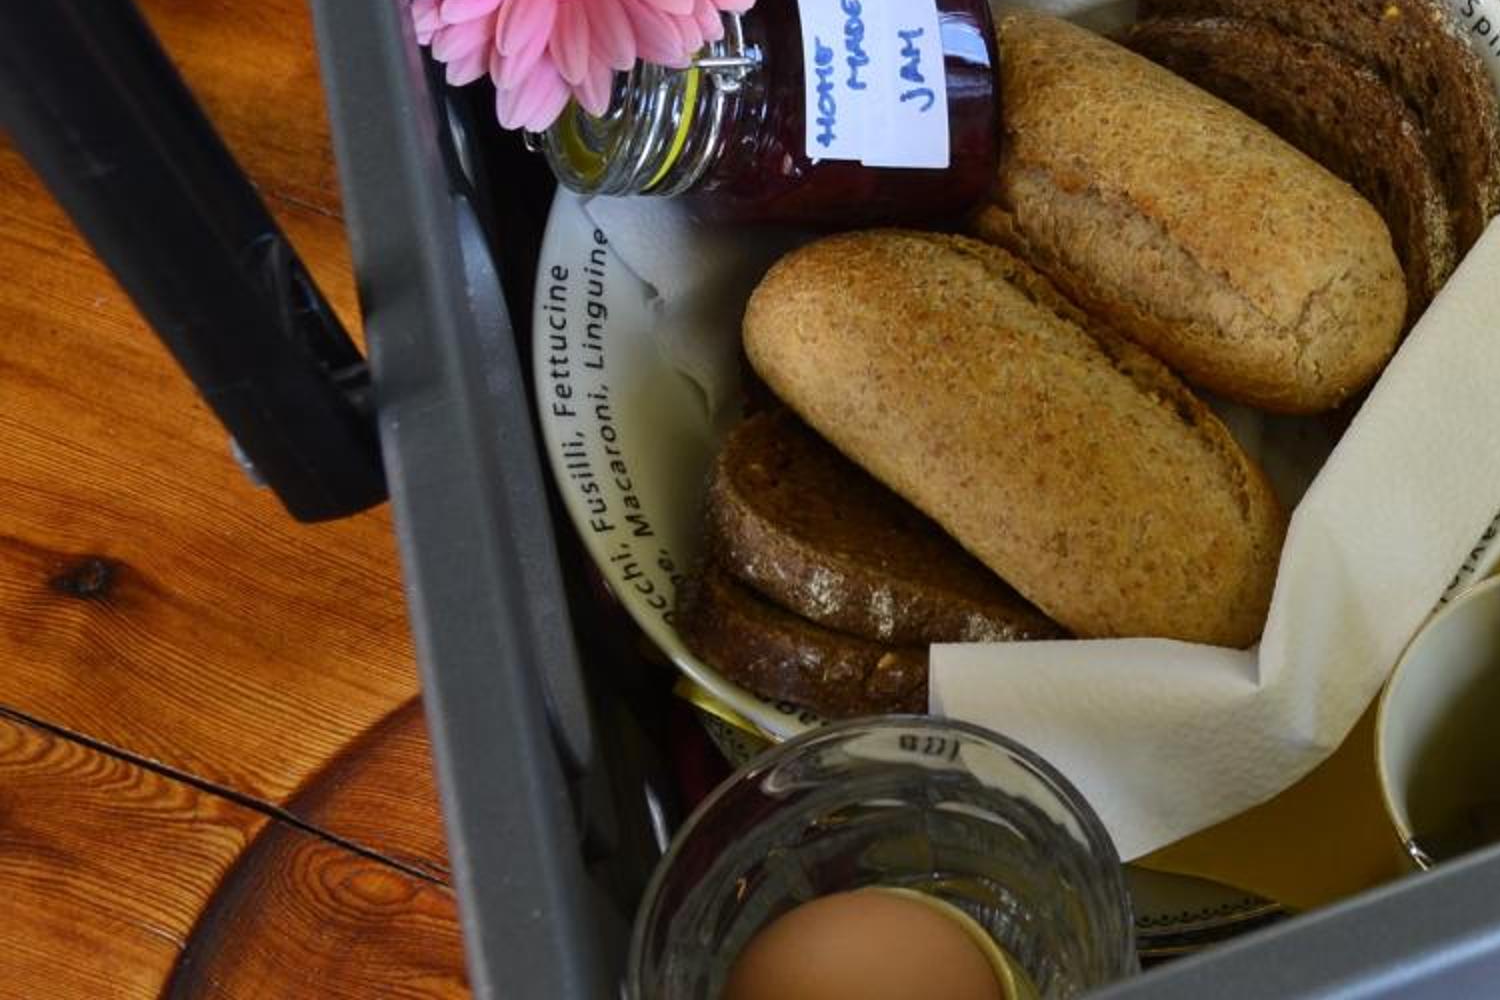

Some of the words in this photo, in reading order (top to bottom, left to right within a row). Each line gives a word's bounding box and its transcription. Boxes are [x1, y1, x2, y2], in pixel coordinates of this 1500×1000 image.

[814, 36, 836, 147] HOME
[898, 27, 935, 112] JAM
[548, 263, 577, 418] Fettucine
[581, 228, 609, 371] Linguine
[560, 430, 616, 535] Fusilli,
[587, 383, 654, 539] Macaroni,
